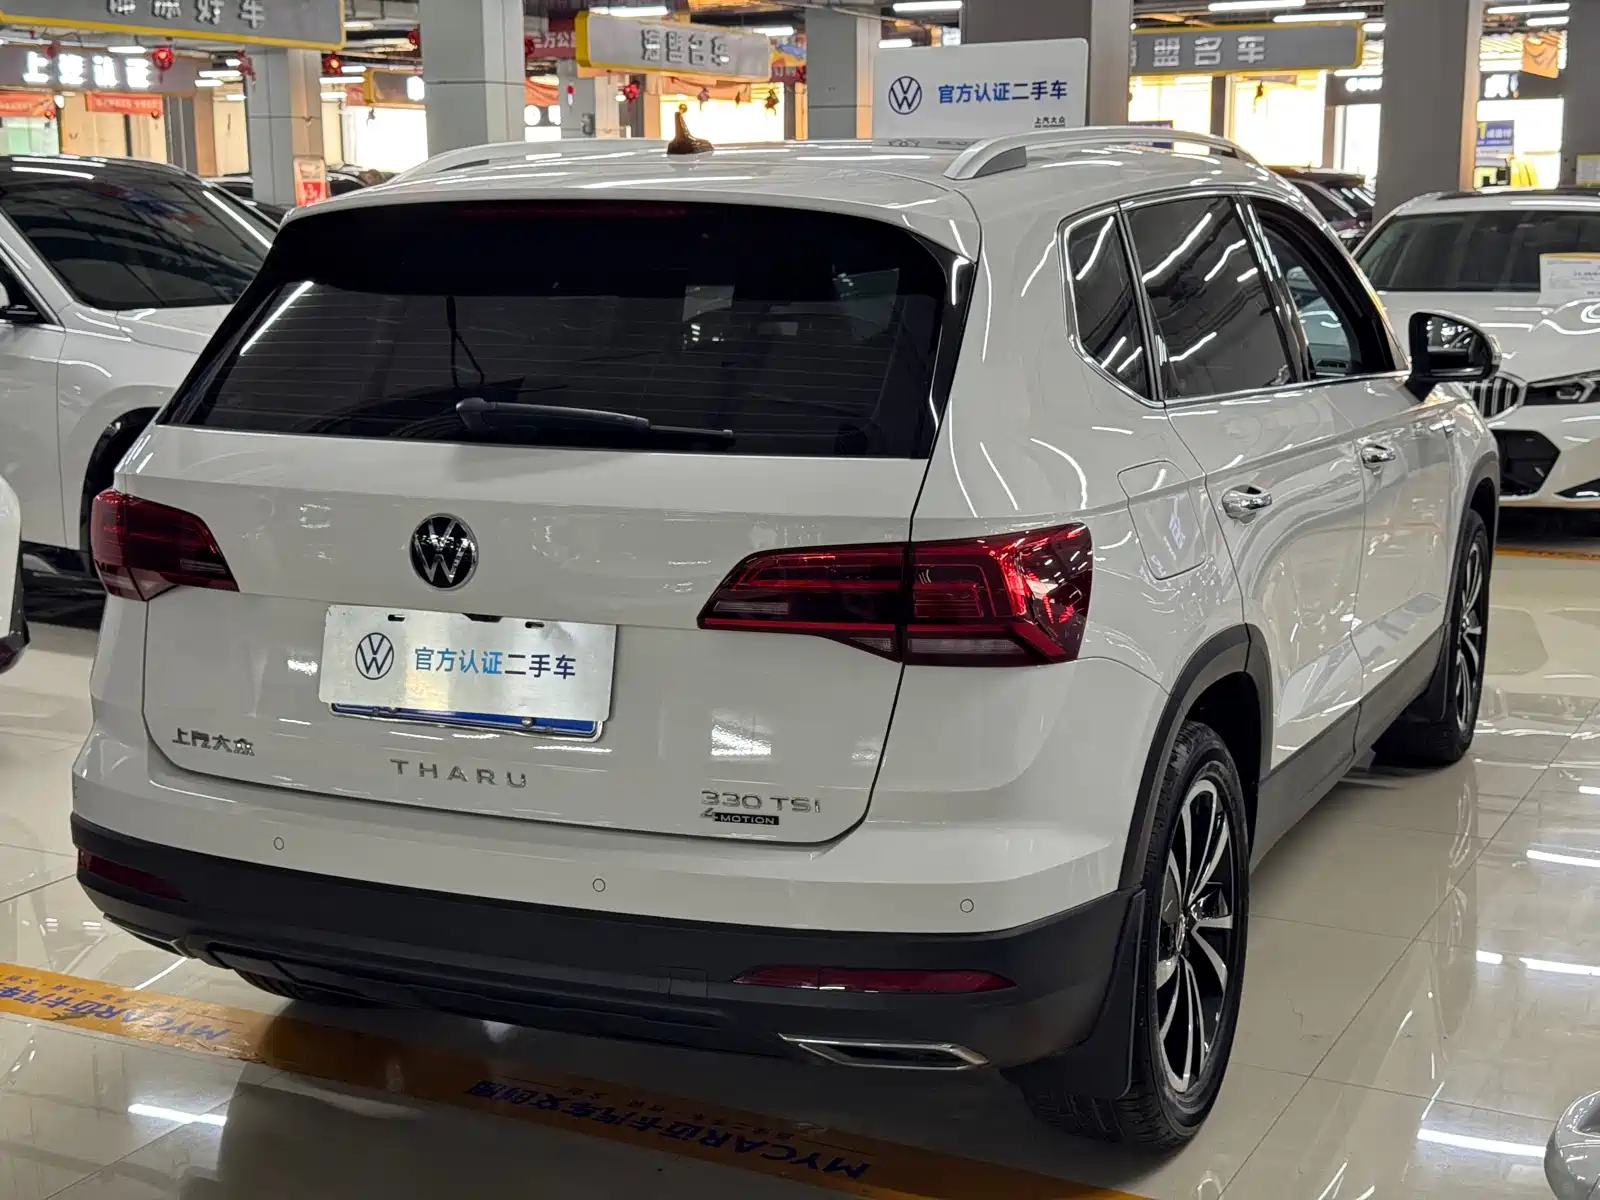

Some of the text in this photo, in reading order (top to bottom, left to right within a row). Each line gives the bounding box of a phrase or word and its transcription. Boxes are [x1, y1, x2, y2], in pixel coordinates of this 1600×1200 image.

[938, 79, 1069, 104] 官方认证二手车
[414, 648, 577, 680] 官方认证二手车
[172, 727, 255, 757] 上汽大众
[390, 758, 528, 789] THARU
[700, 790, 762, 809] 330
